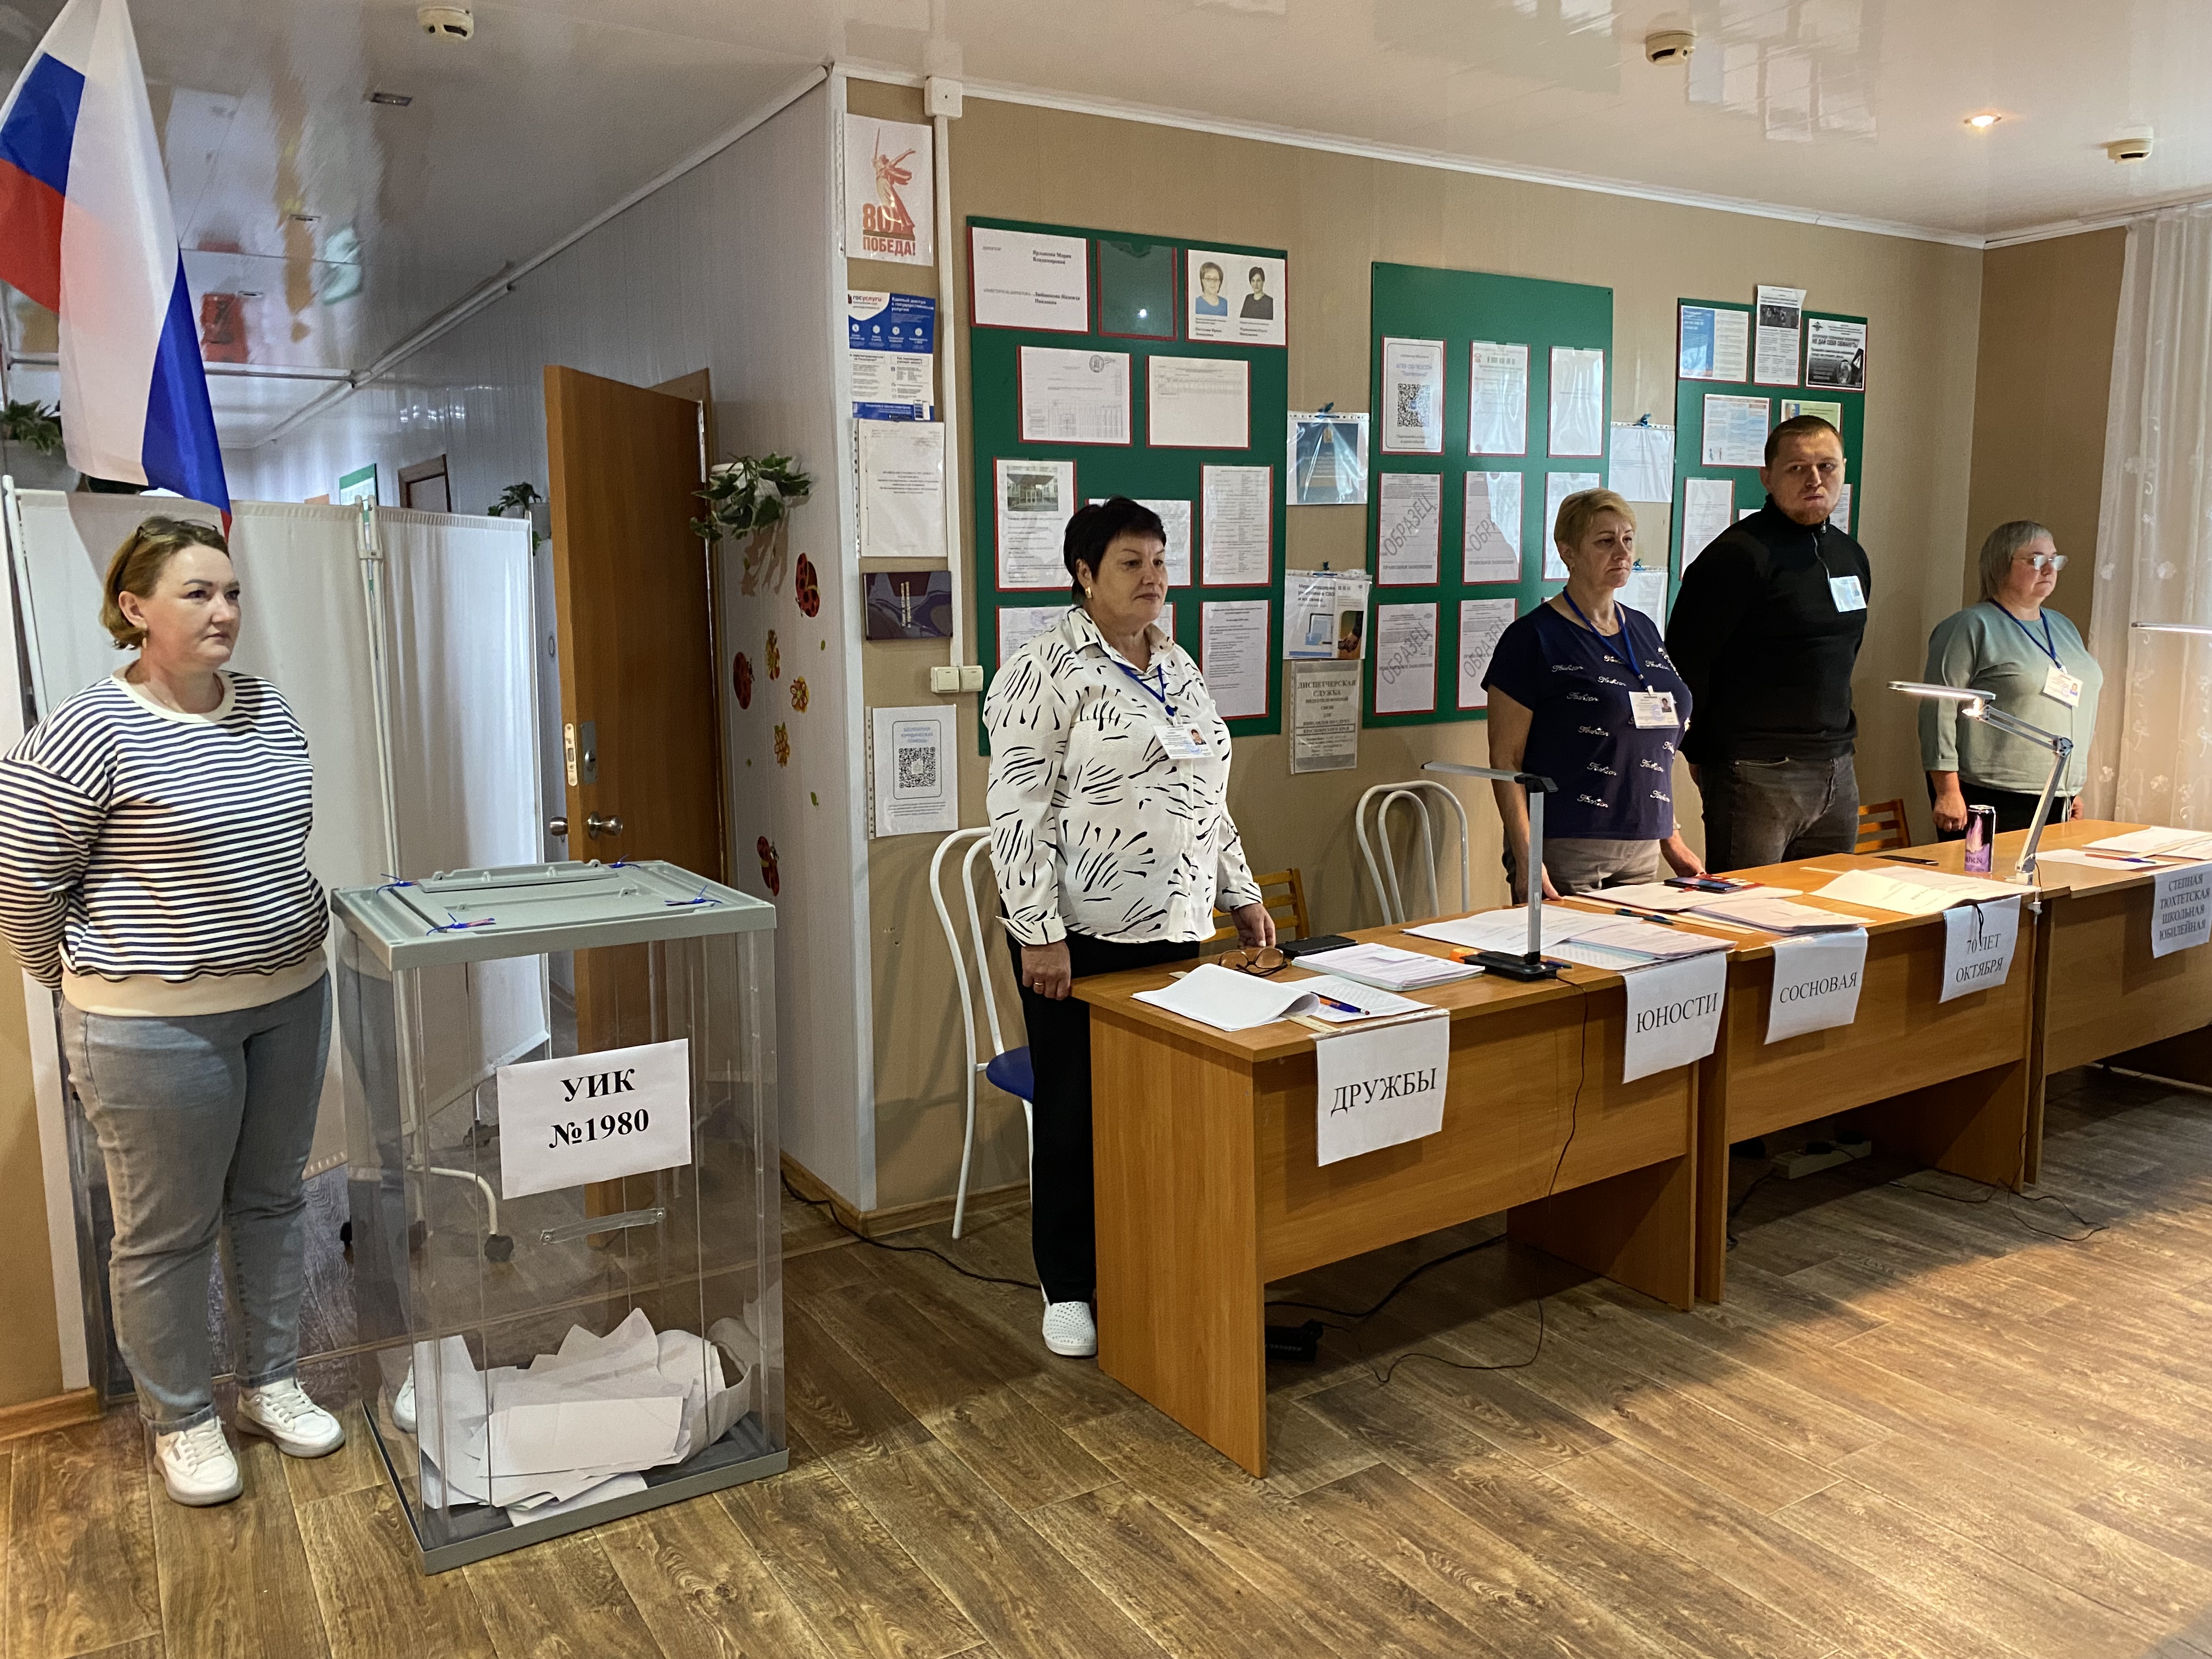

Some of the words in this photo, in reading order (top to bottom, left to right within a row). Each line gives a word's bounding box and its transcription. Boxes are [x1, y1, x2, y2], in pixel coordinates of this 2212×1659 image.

[863, 236, 916, 256] ПОБЕДА!
[1384, 493, 1437, 556] ОБРАЗЕЦ
[1382, 622, 1432, 684] ОБРАЗЕЦ
[1297, 680, 1356, 689] ДИСПЕТЧЕРСКАЯ
[1567, 692, 1599, 702] Fashion
[1578, 726, 1609, 736] Fashion
[1587, 762, 1617, 776] Fashion
[1577, 794, 1609, 808] Fashion
[2169, 874, 2203, 891] СТЕПНАЯ
[2162, 904, 2204, 924] ШКОЛЬНАЯ
[2159, 919, 2206, 941] ЮБИЛЕЙНАЯ
[1966, 939, 1978, 955] 70
[1979, 933, 2001, 951] ЛЕТ
[1956, 957, 2004, 983] ОКТЯБРЯ
[1780, 972, 1858, 1003] СОСНОВАЯ
[1635, 992, 1718, 1034] ЮНОСТИ
[560, 1068, 635, 1102] УИК
[1330, 1068, 1437, 1118] ДРУЖБЫ
[549, 1109, 649, 1149] №1980
